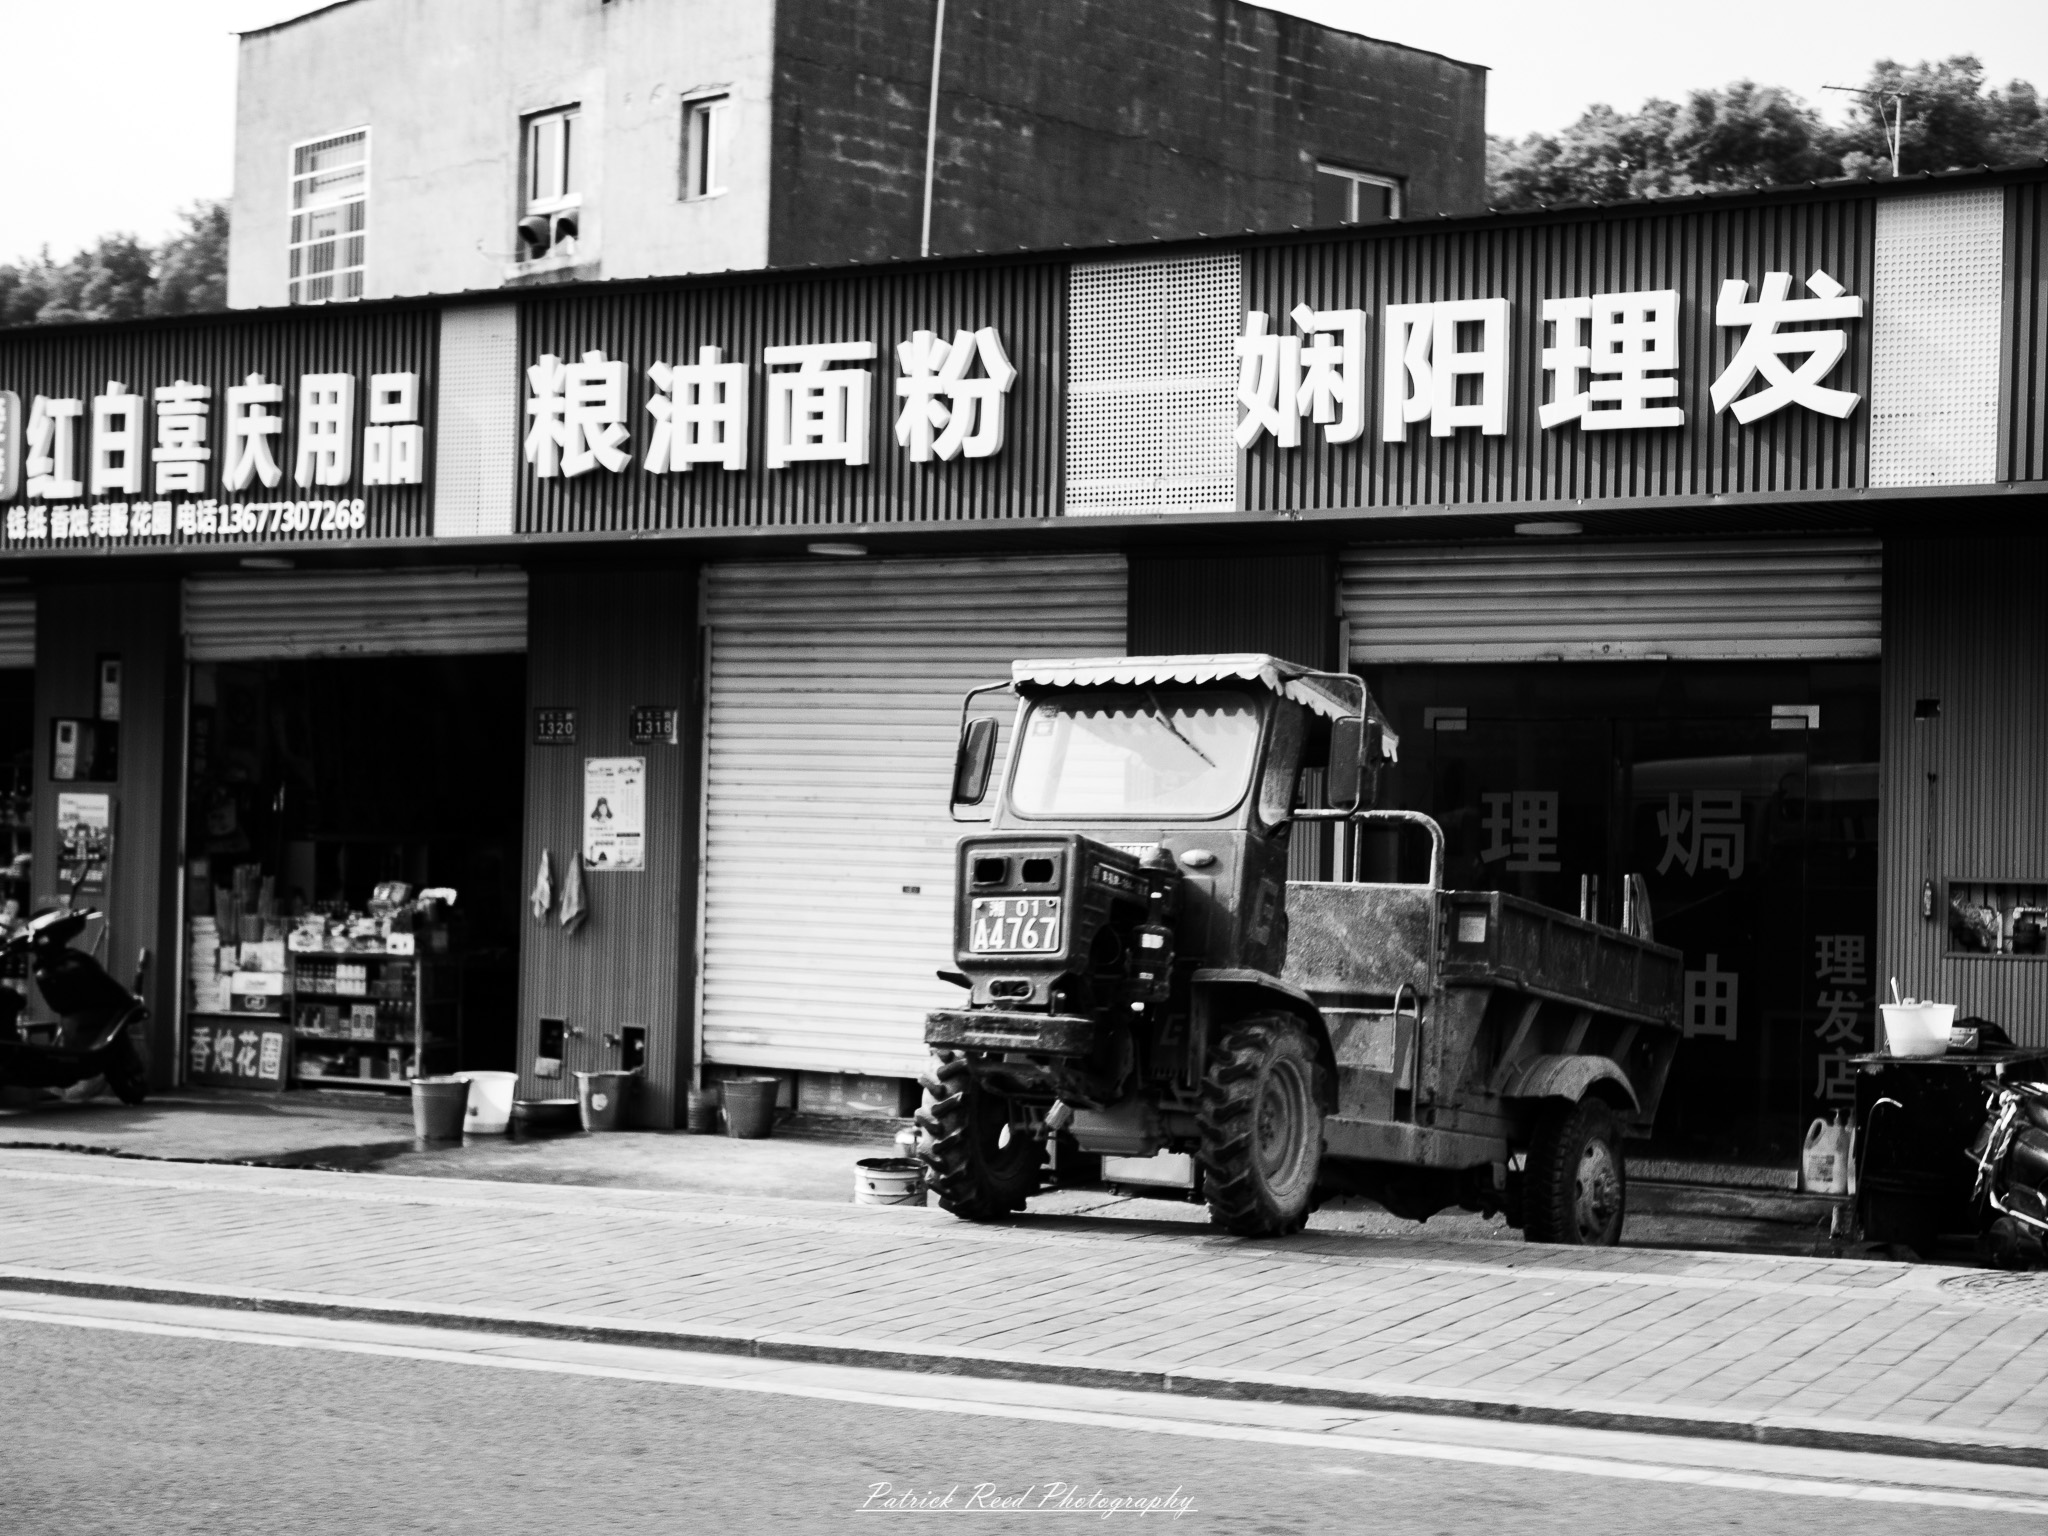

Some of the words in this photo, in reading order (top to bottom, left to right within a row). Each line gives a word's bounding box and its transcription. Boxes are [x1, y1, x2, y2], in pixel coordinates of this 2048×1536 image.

[1234, 269, 1863, 449] 娴阳理发
[524, 326, 1018, 477] 粮油面粉
[26, 372, 424, 499] 红白喜庆用品
[539, 722, 573, 735] 1320
[637, 721, 672, 734] 1318
[1016, 900, 1039, 917] 01
[973, 917, 1056, 949] A4767
